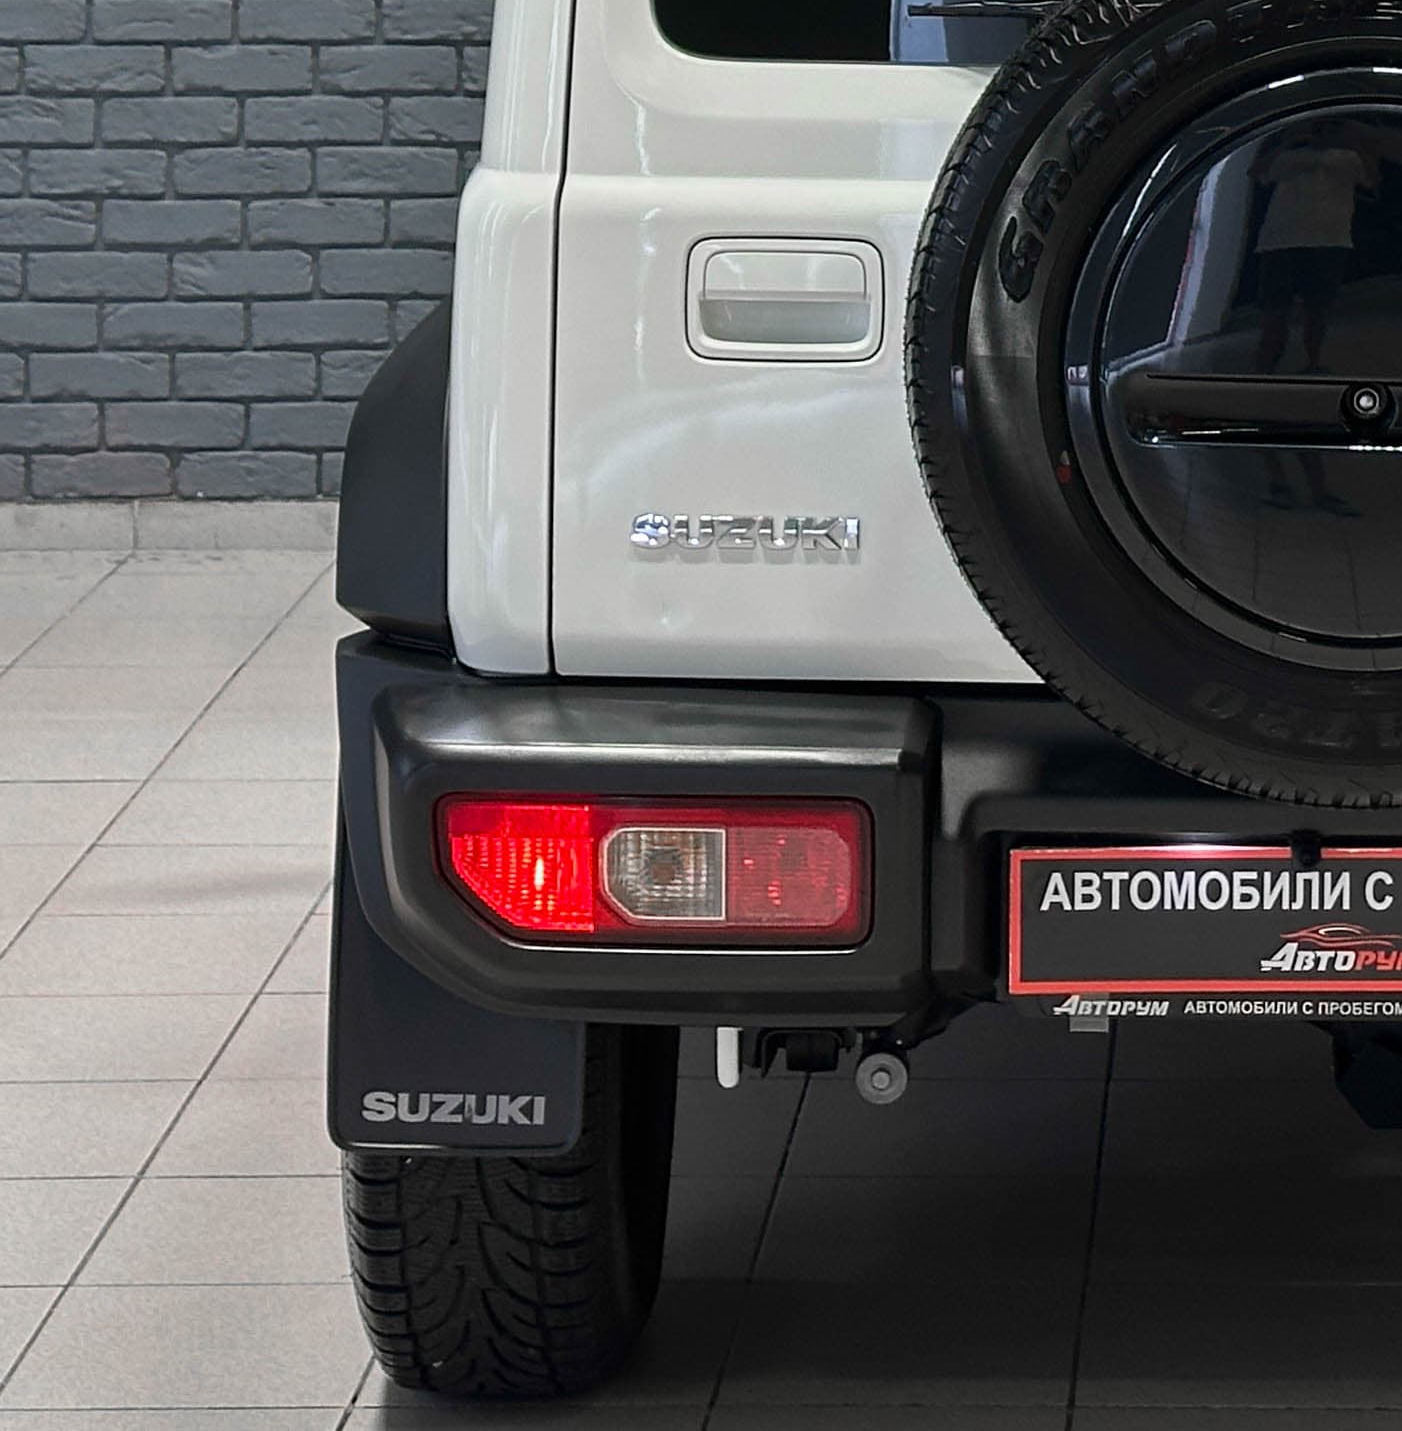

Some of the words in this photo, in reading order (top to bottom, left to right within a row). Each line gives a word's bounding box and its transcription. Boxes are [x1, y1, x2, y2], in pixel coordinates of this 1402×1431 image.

[630, 513, 860, 551] SUZUKI
[1040, 870, 1351, 912] АВТОМОБИЛИ
[1365, 870, 1394, 912] С
[1184, 1000, 1298, 1016] АВТОМОБИЛИ
[1302, 1001, 1314, 1016] С
[361, 1091, 547, 1126] SUZUKI
